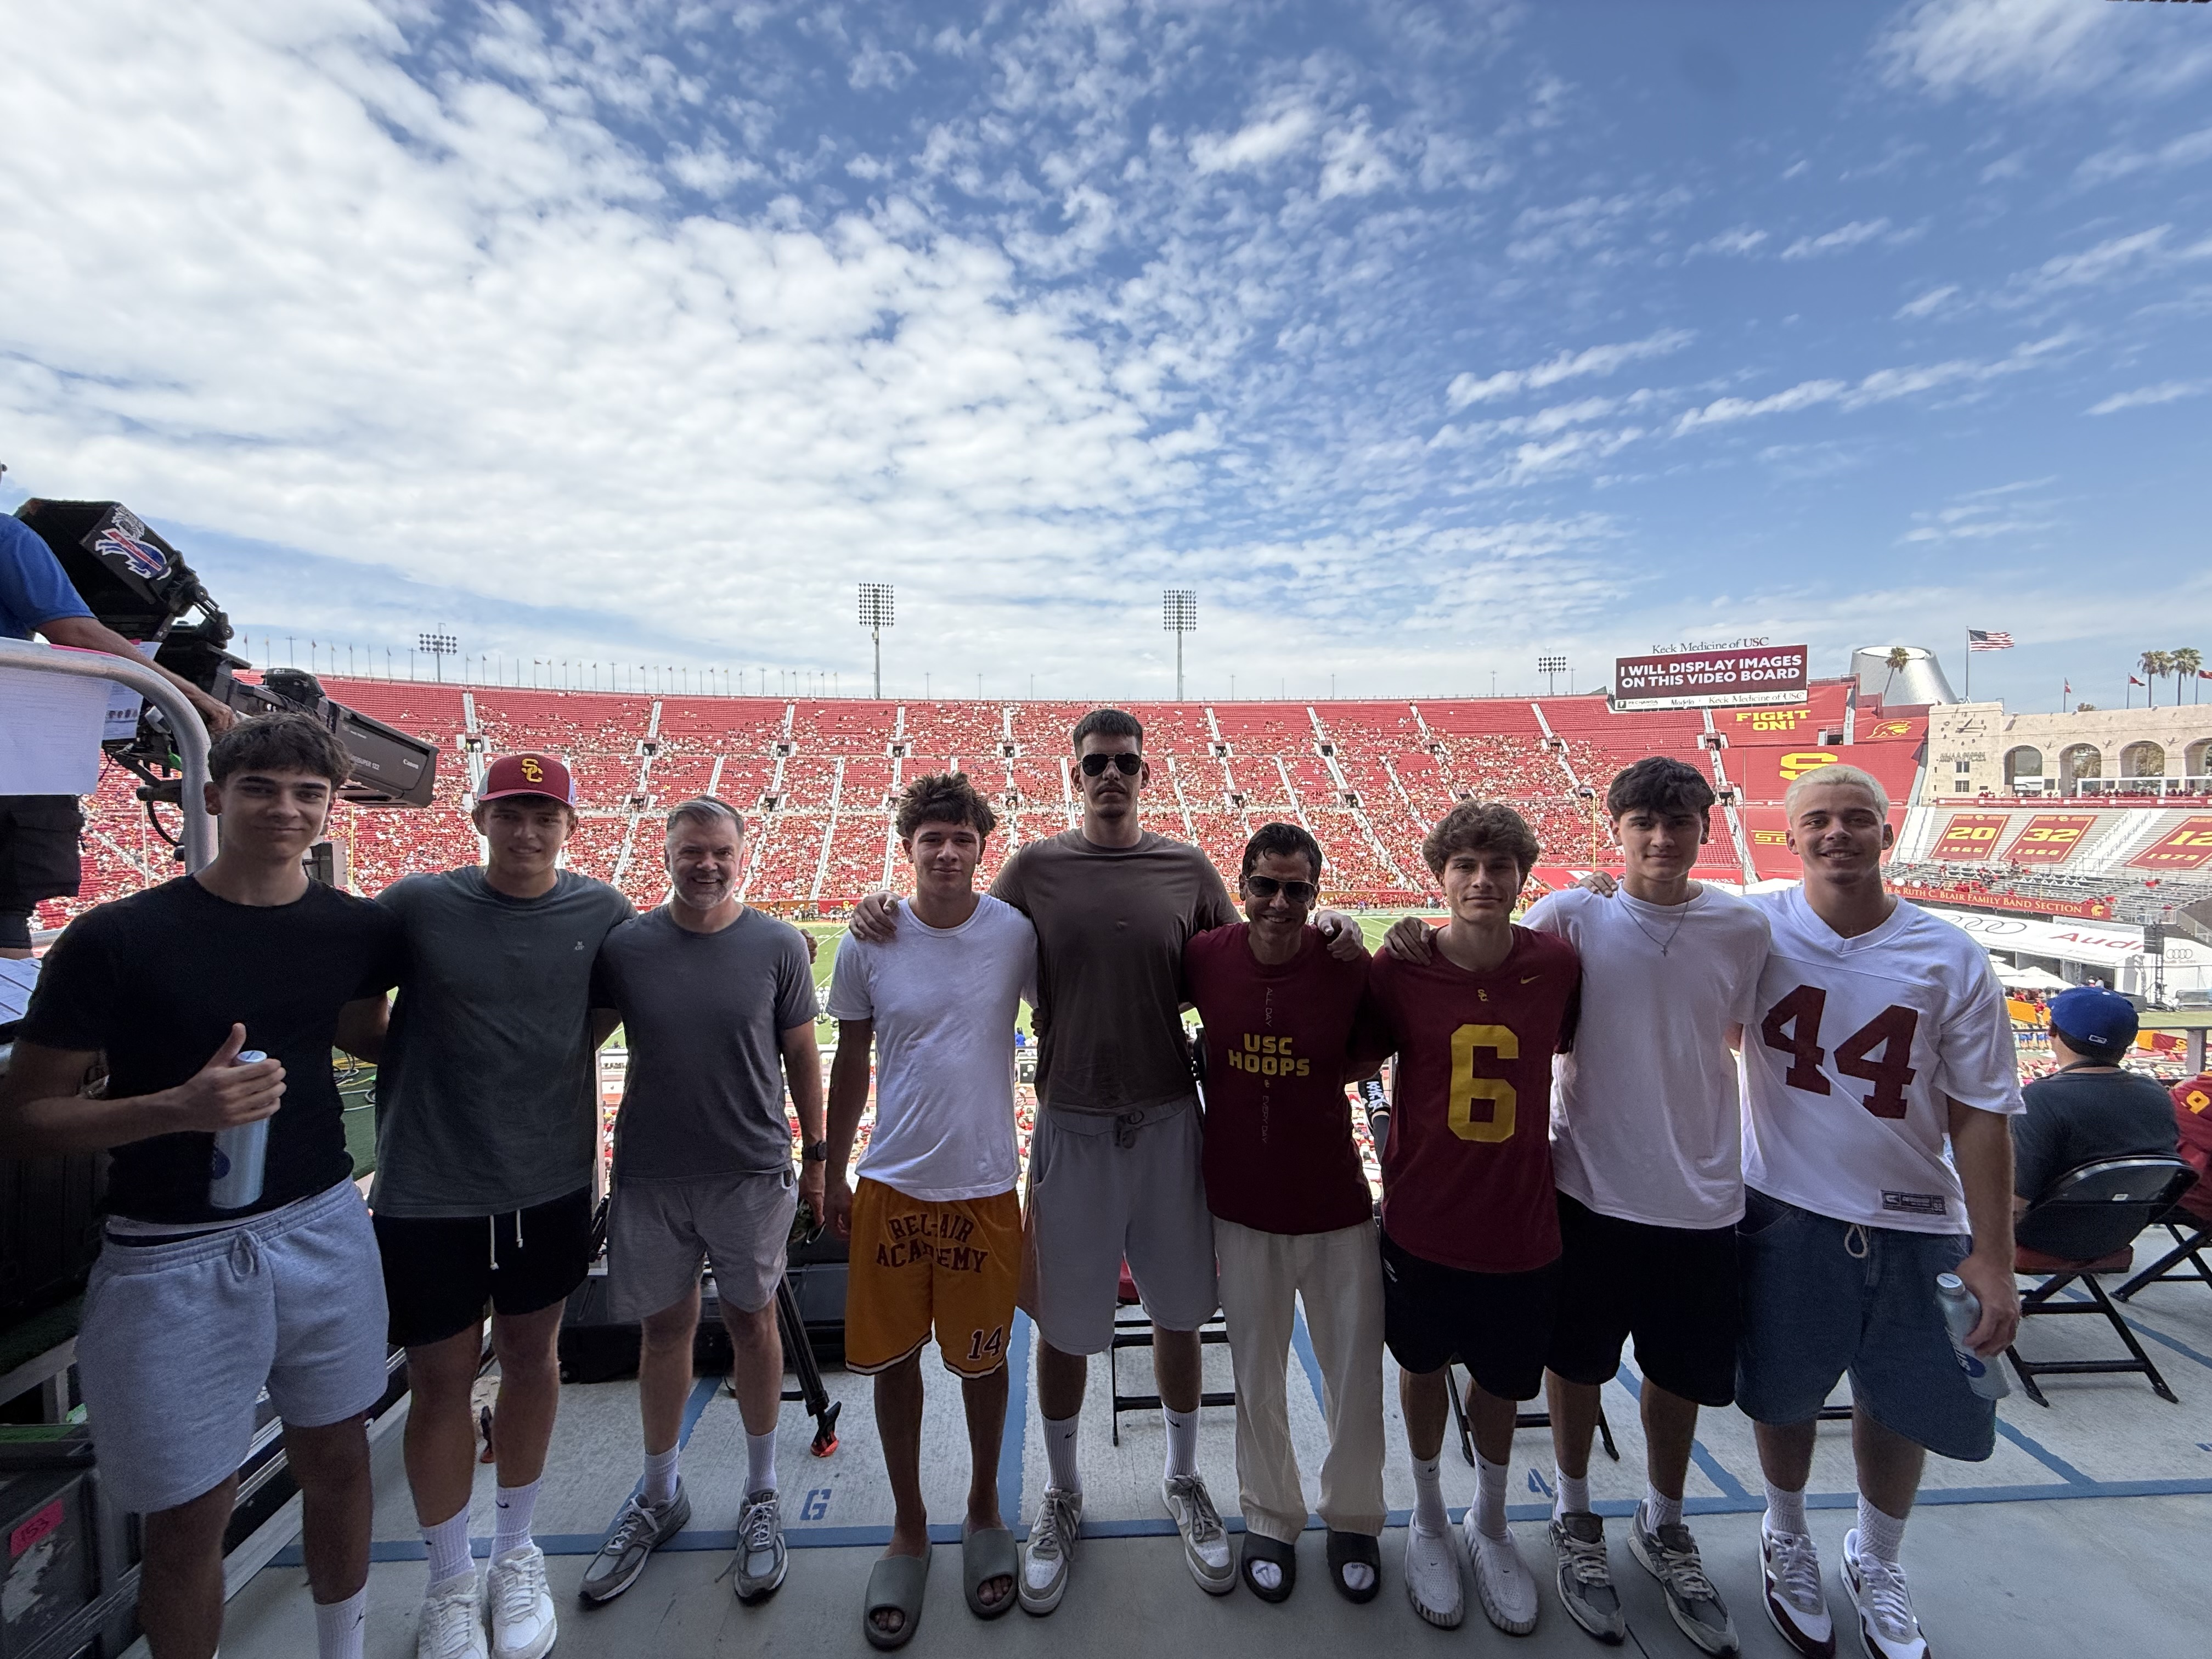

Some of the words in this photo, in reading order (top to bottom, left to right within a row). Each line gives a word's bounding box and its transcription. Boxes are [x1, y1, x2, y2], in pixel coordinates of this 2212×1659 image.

[1652, 645, 1676, 654] Keck
[1680, 641, 1727, 653] Medicine
[1729, 639, 1740, 648] of
[1743, 637, 1770, 647] USC
[1620, 667, 1626, 677] I
[1628, 664, 1666, 676] WILL
[1669, 659, 1736, 674] DISPLAY
[1739, 655, 1803, 668] IMAGES
[1622, 677, 1645, 688] ON
[1648, 674, 1684, 686] THIS
[1687, 671, 1737, 684] VIDEO
[1741, 668, 1801, 681] BOARD
[1732, 694, 1770, 703] Medicine
[1736, 710, 1811, 721] FIGHT
[1753, 720, 1796, 730] ON!
[521, 758, 543, 783] SC
[1946, 827, 1996, 839] 20
[2022, 828, 2080, 842] 32
[2166, 831, 2212, 845] 12
[1903, 887, 1926, 897] RUTH
[1928, 889, 1937, 898] C.
[1940, 891, 1965, 901] BLAIR
[1967, 894, 2001, 905] FAMILY
[2004, 897, 2032, 908] BAND
[2035, 901, 2083, 914] SECTION
[1477, 989, 1489, 1002] SC
[1244, 1033, 1293, 1055] USC
[1761, 984, 1918, 1120] 44
[1228, 1049, 1310, 1076] HOOPS
[1448, 1024, 1519, 1143] 6
[888, 1213, 974, 1243] BEL-AIR
[876, 1238, 988, 1273] ACADEMY
[967, 1324, 1003, 1361] 14
